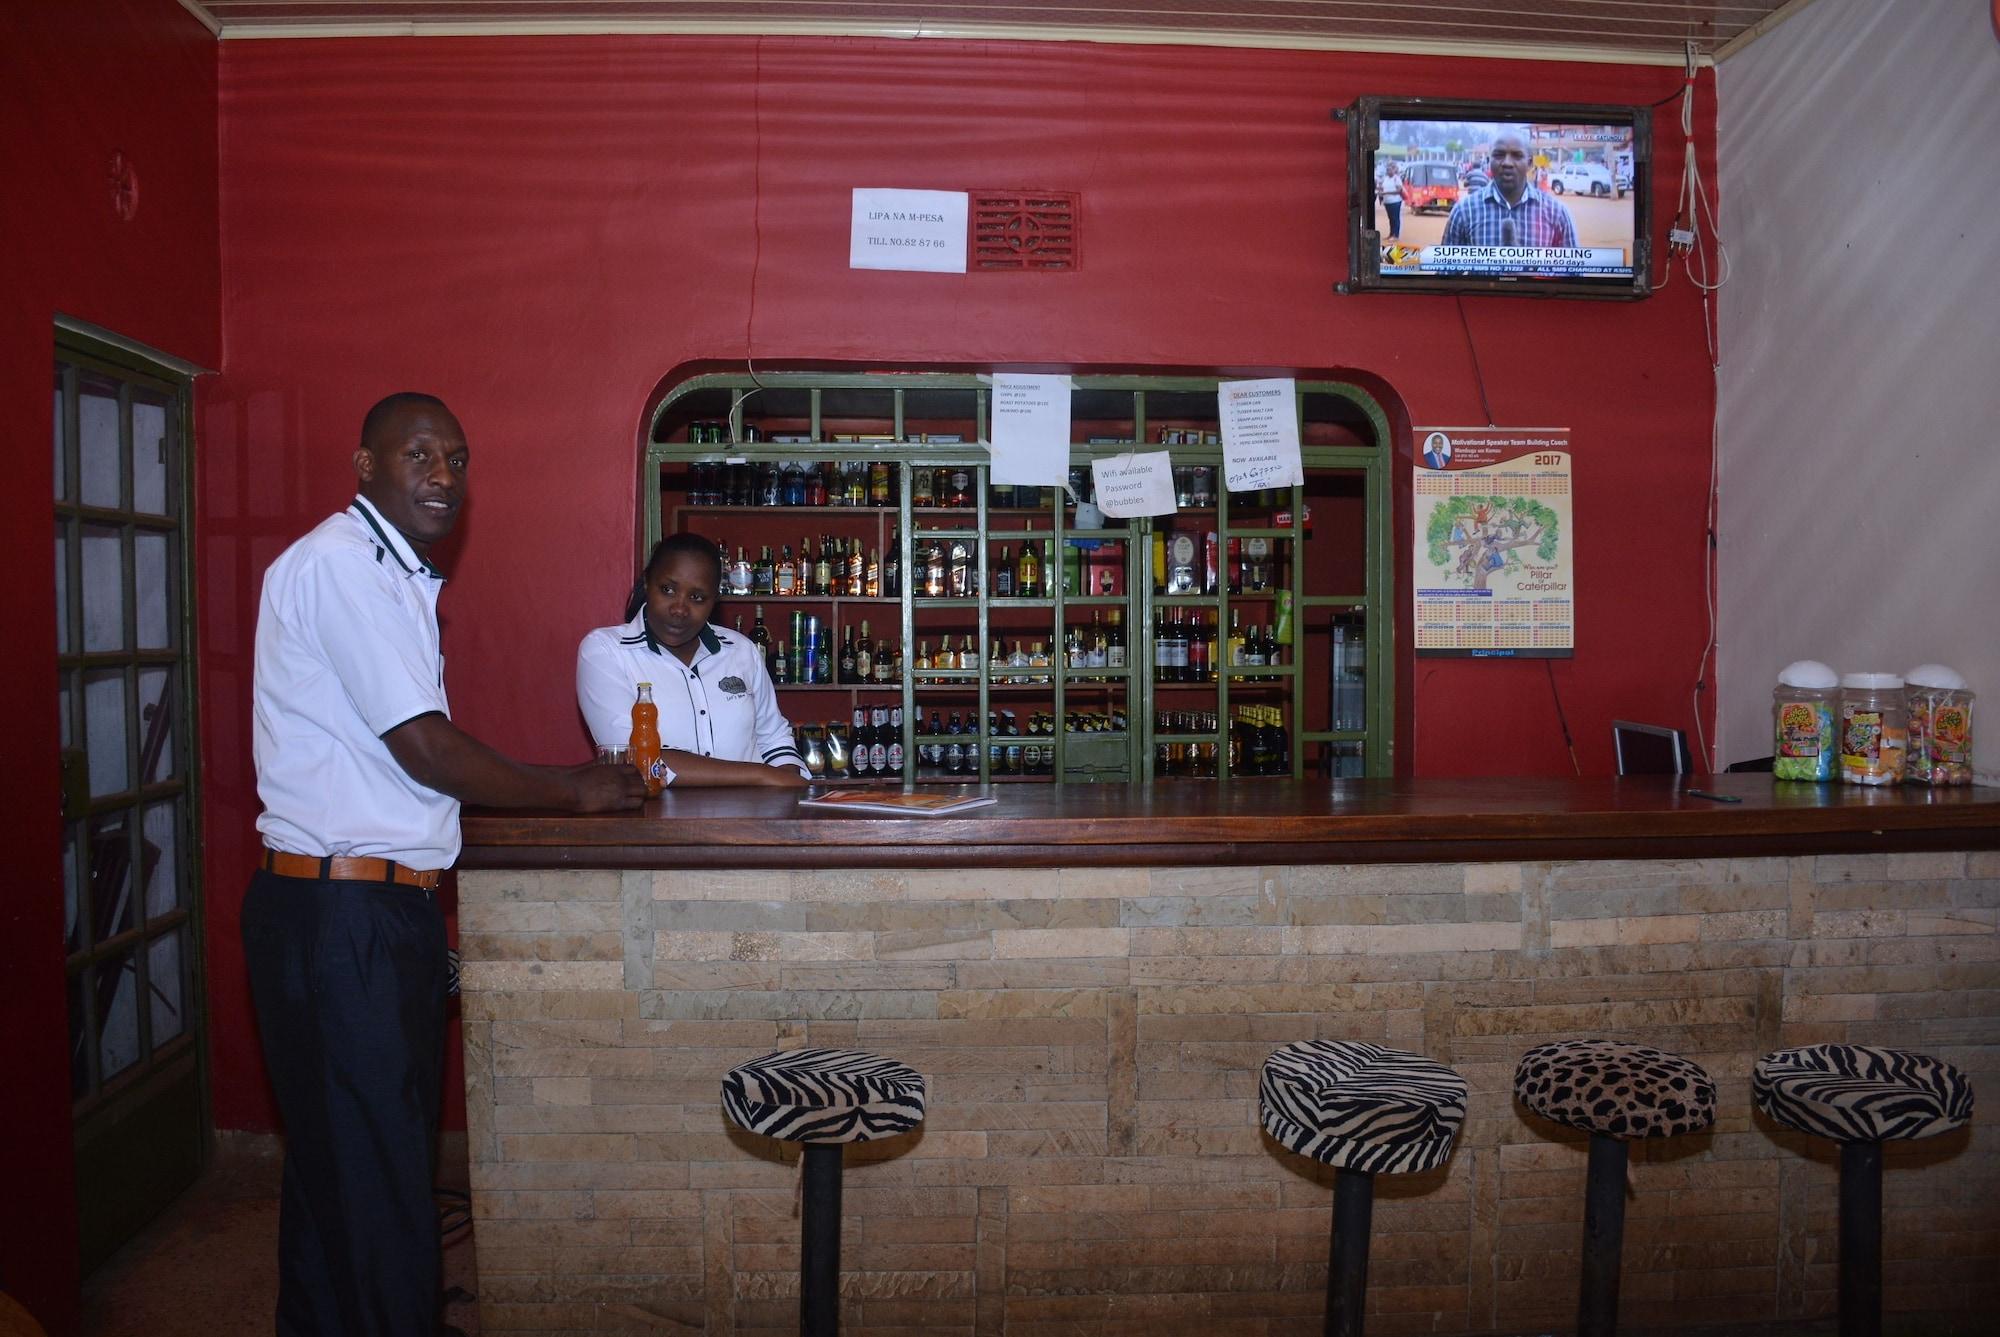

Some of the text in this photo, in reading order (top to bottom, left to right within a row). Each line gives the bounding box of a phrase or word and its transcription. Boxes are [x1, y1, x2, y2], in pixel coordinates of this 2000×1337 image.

[868, 211, 945, 223] LIPA NA M-PESA
[867, 236, 888, 246] TILL
[890, 237, 917, 247] NO.82
[1433, 247, 1593, 259] SUPREME COURT RULING
[1433, 257, 1461, 265] Judges
[1463, 257, 1486, 265] order
[1486, 257, 1508, 265] fresh
[1509, 258, 1544, 266] election
[1544, 258, 1552, 266] in
[1566, 259, 1586, 267] days
[1233, 389, 1282, 399] DEAR CUSTOMERS
[1450, 438, 1486, 446] Motivational
[1486, 438, 1510, 447] Speaker
[1526, 439, 1550, 447] Building
[1248, 455, 1278, 463] AVAILABLE
[1534, 454, 1562, 466] 2017
[1101, 465, 1153, 479] Wifi available
[1105, 480, 1143, 493] Password
[1105, 496, 1145, 509] @bubbles
[1530, 570, 1553, 580] Pillar
[1516, 581, 1567, 593] Caterpillar
